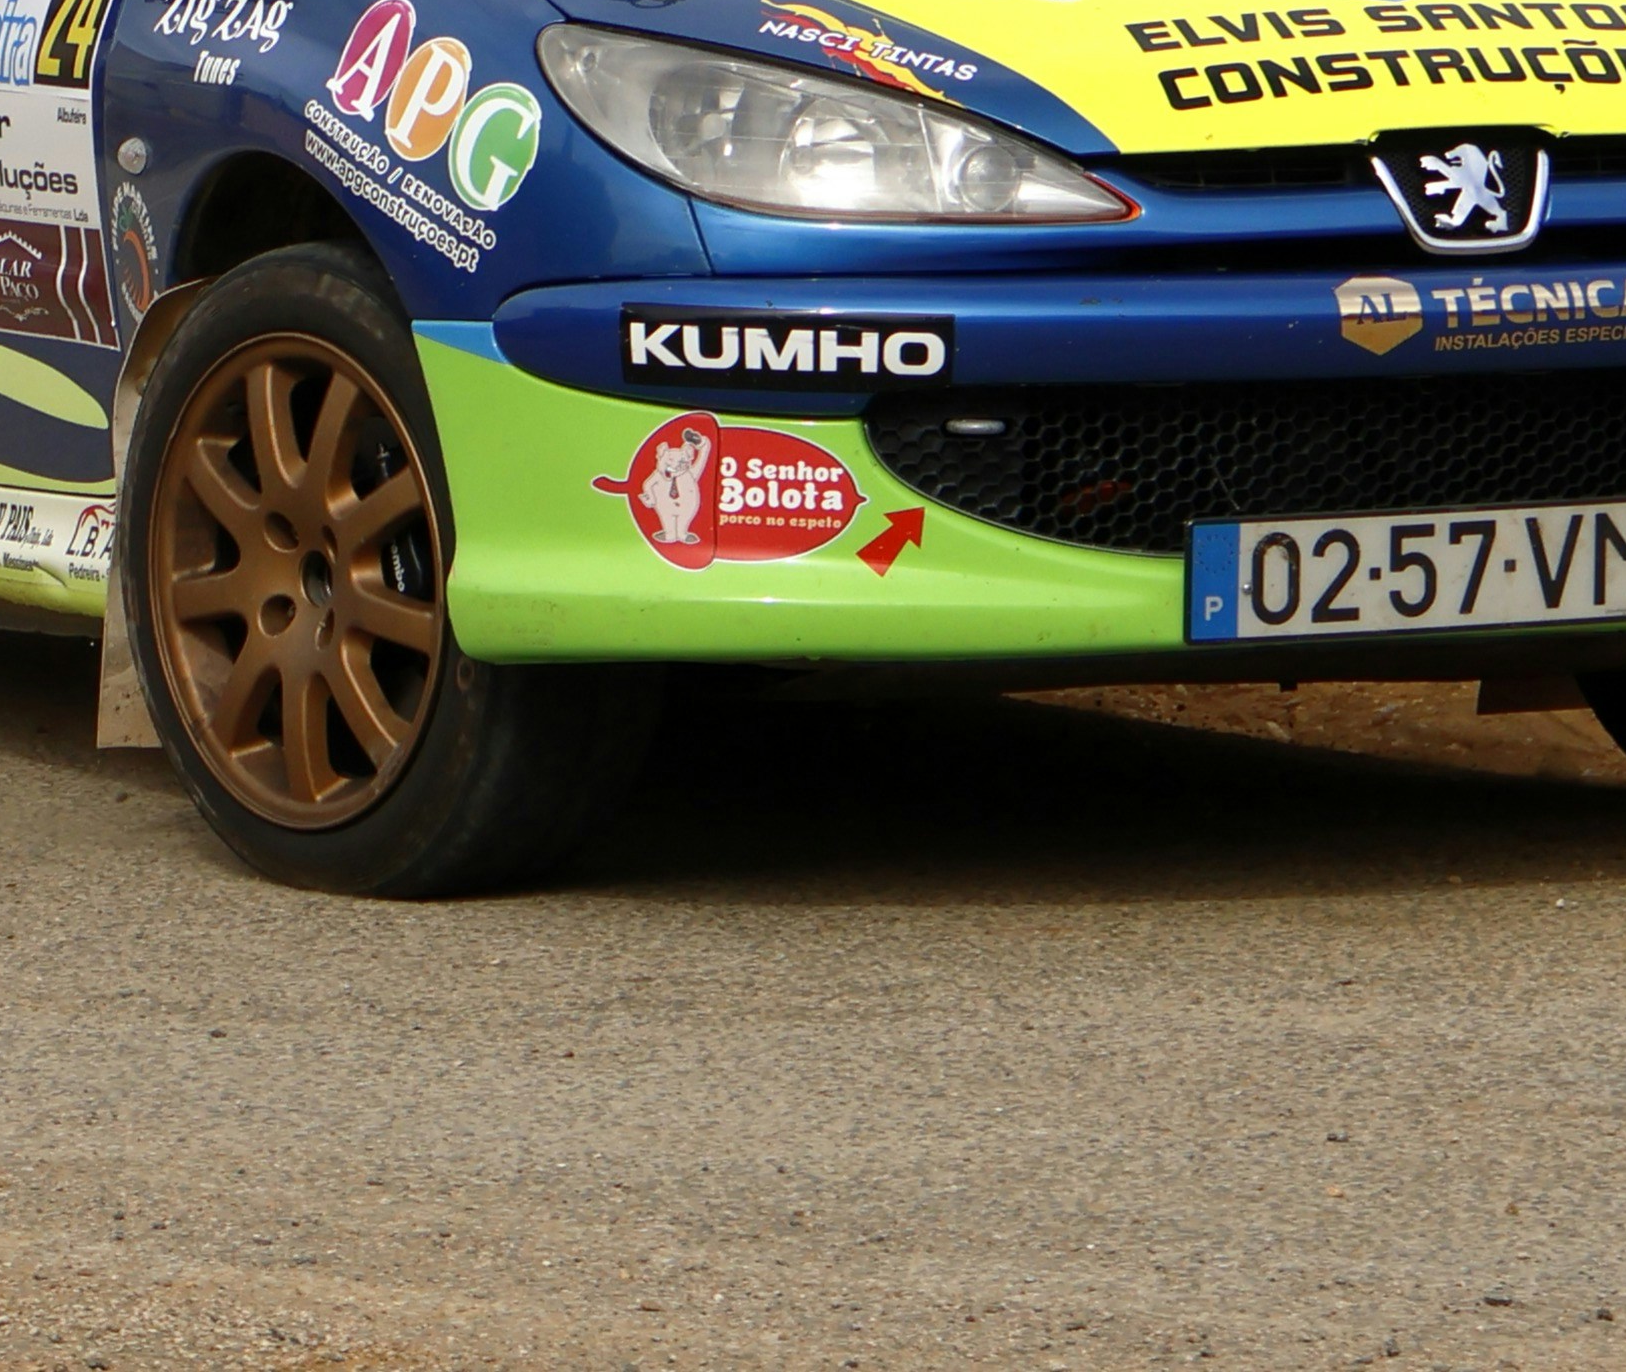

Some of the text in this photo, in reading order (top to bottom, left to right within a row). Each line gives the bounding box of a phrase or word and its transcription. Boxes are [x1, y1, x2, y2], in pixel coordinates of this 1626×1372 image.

[1125, 5, 1347, 52] ELVIS
[759, 18, 979, 82] NASCI TINTAS
[327, 4, 539, 211] APG
[304, 100, 390, 175] CONSTRUÇÃO
[401, 174, 496, 250] RENOVAÇÃO
[629, 322, 946, 376] KUMHO
[1435, 327, 1560, 351] INSTALAÇÕES
[745, 458, 844, 482] Senhor
[719, 478, 843, 512] Bolota
[719, 514, 842, 531] porco no espeto
[68, 562, 101, 582] Pedreira
[1205, 596, 1222, 621] P
